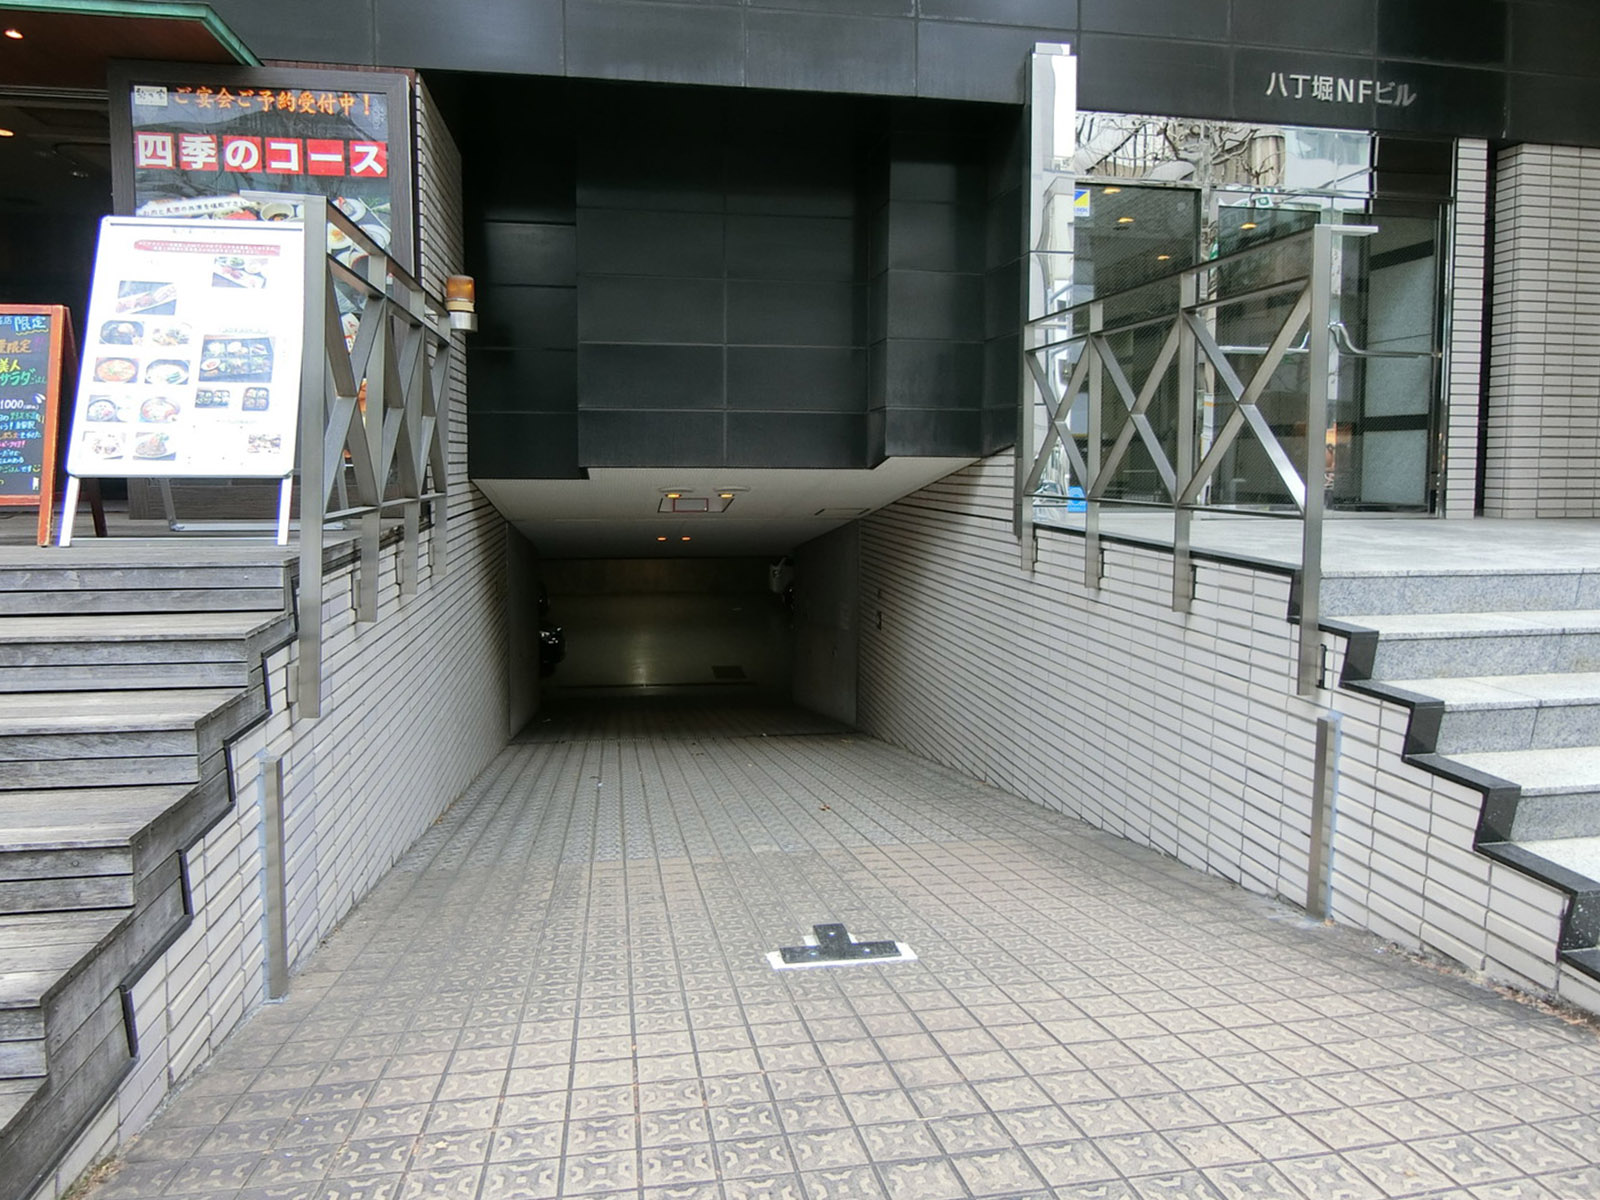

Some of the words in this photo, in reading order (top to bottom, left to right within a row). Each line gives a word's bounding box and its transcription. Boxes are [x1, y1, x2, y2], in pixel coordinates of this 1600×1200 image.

[1265, 71, 1417, 106] 八丁堀NFビル
[137, 135, 385, 176] 四季のコース
